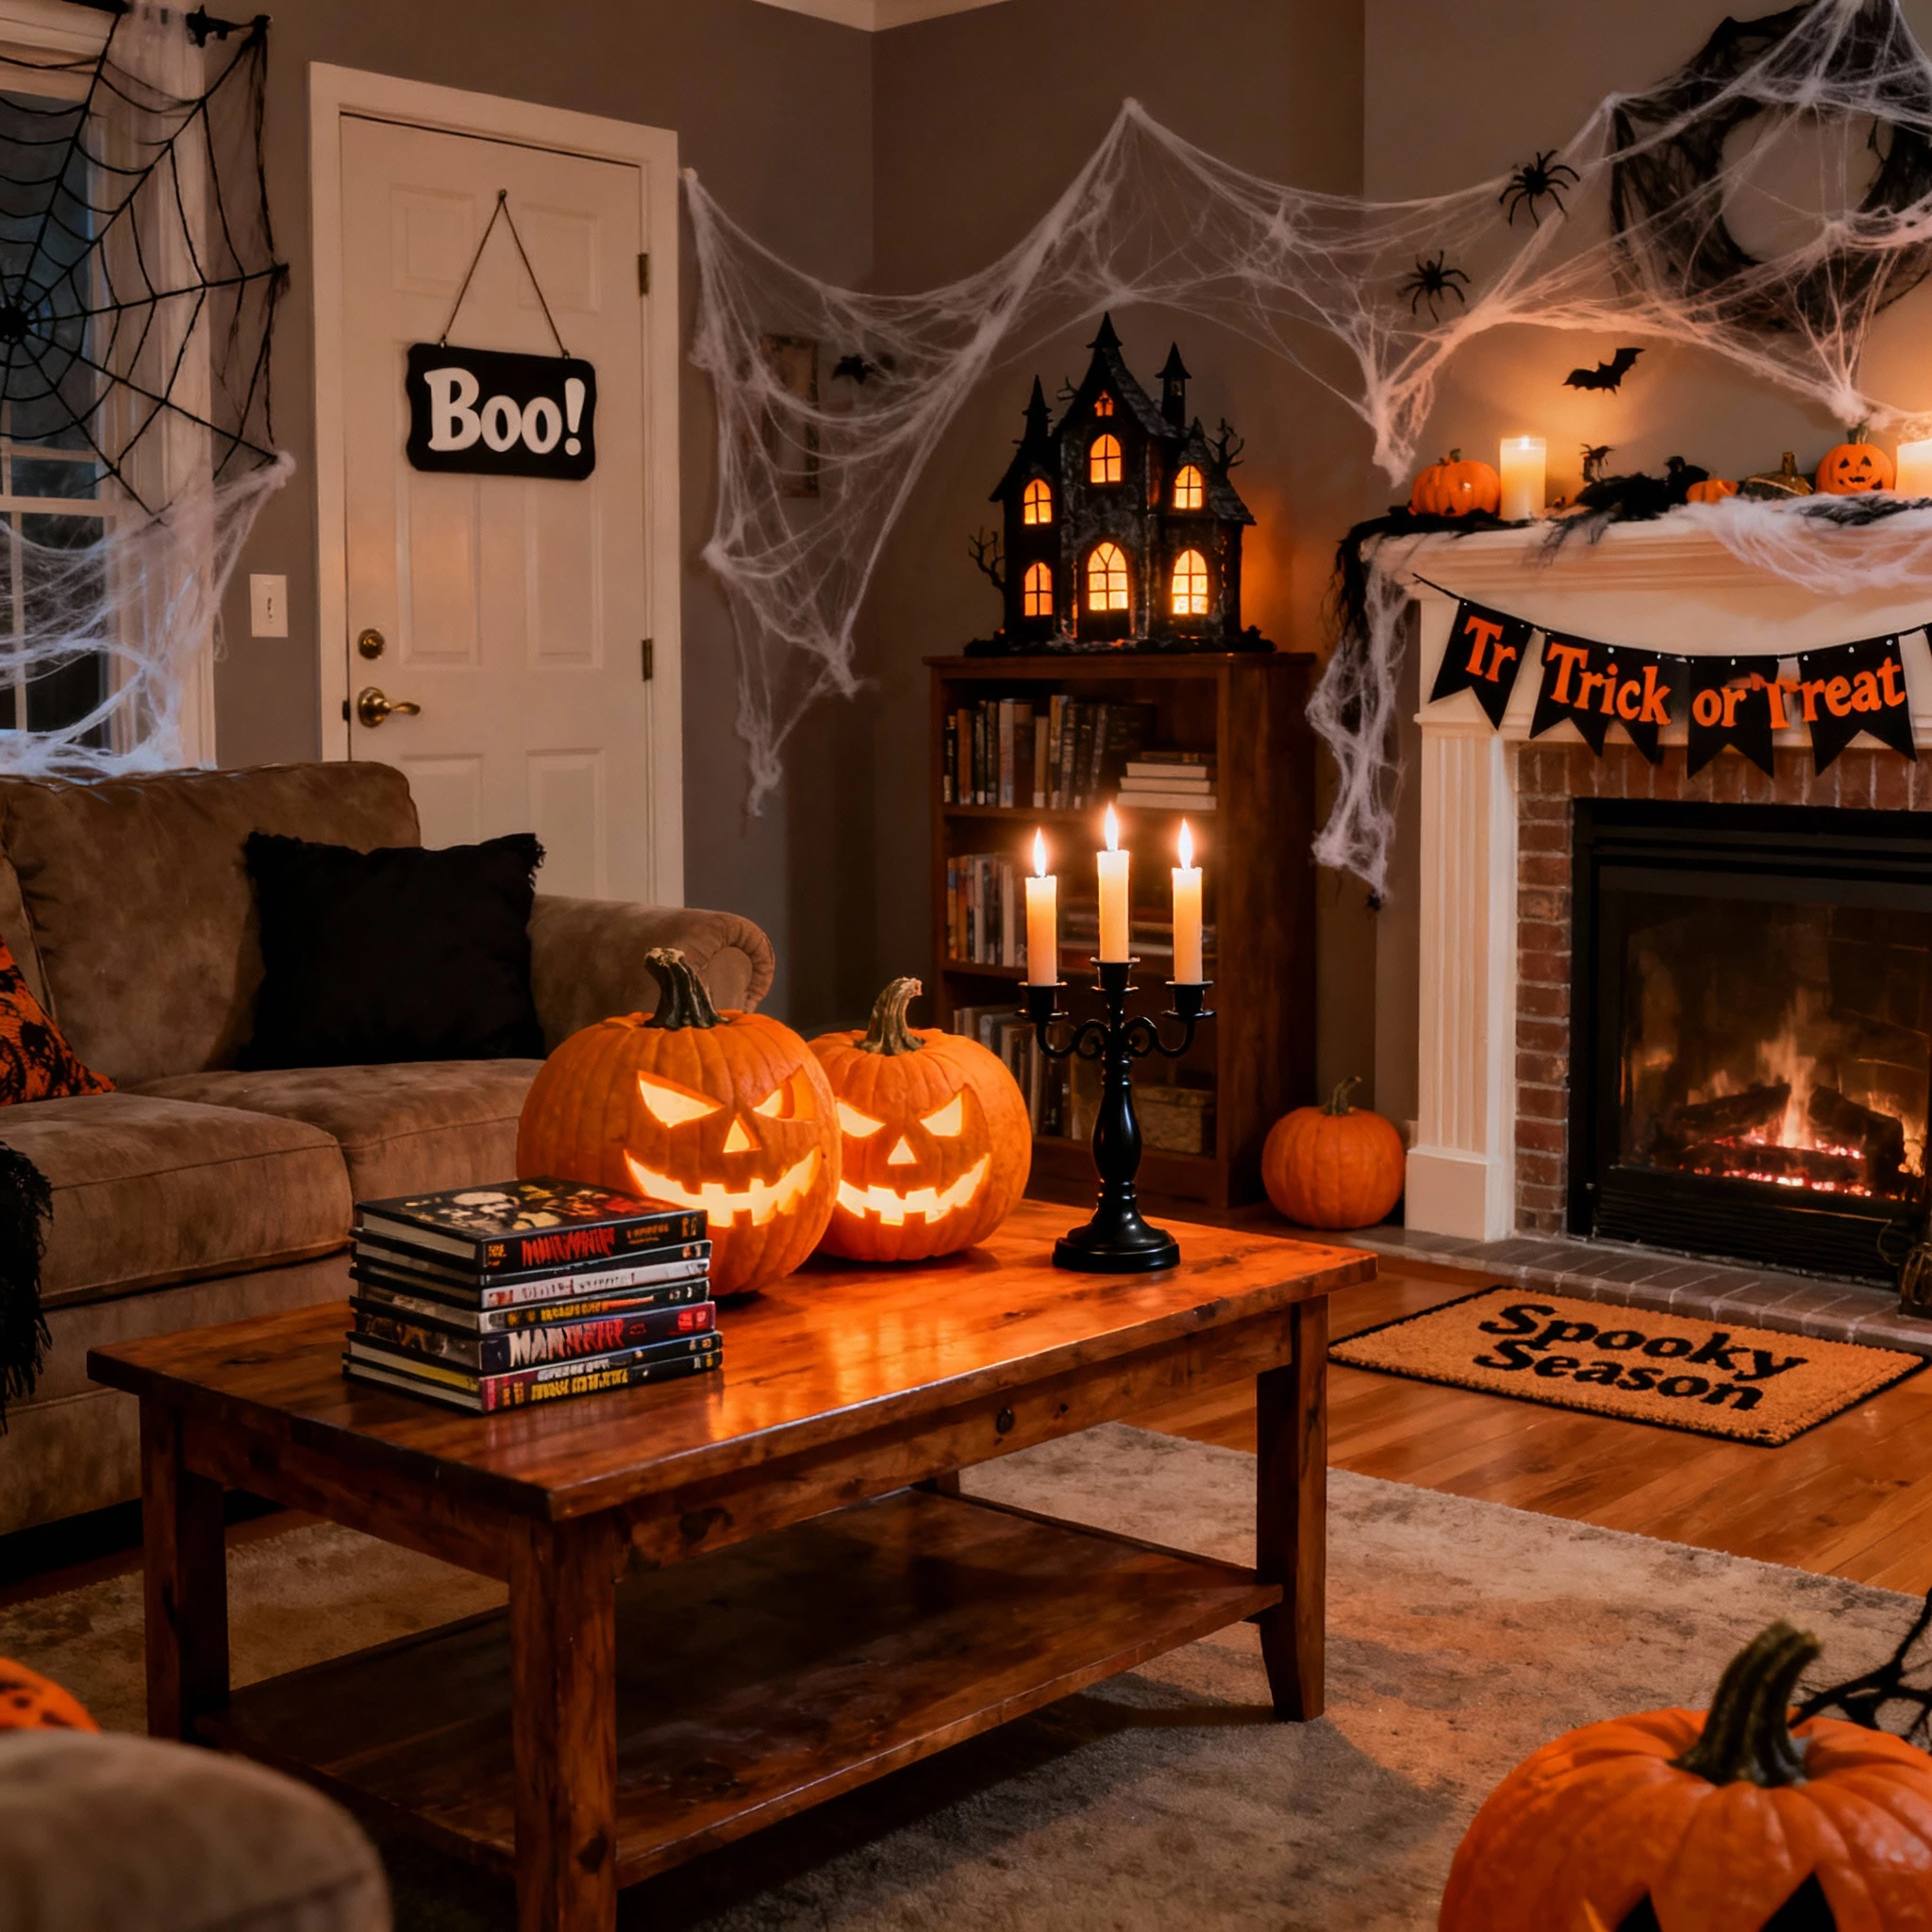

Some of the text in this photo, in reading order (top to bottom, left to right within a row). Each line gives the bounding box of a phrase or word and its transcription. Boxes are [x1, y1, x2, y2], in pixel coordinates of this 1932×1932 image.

[424, 367, 586, 457] Boo!
[1463, 616, 1516, 683] Tr
[1546, 641, 1671, 726] Trick
[1692, 686, 1747, 727] or
[1474, 1340, 1764, 1410] Season
[1478, 1305, 1808, 1381] Spooky
